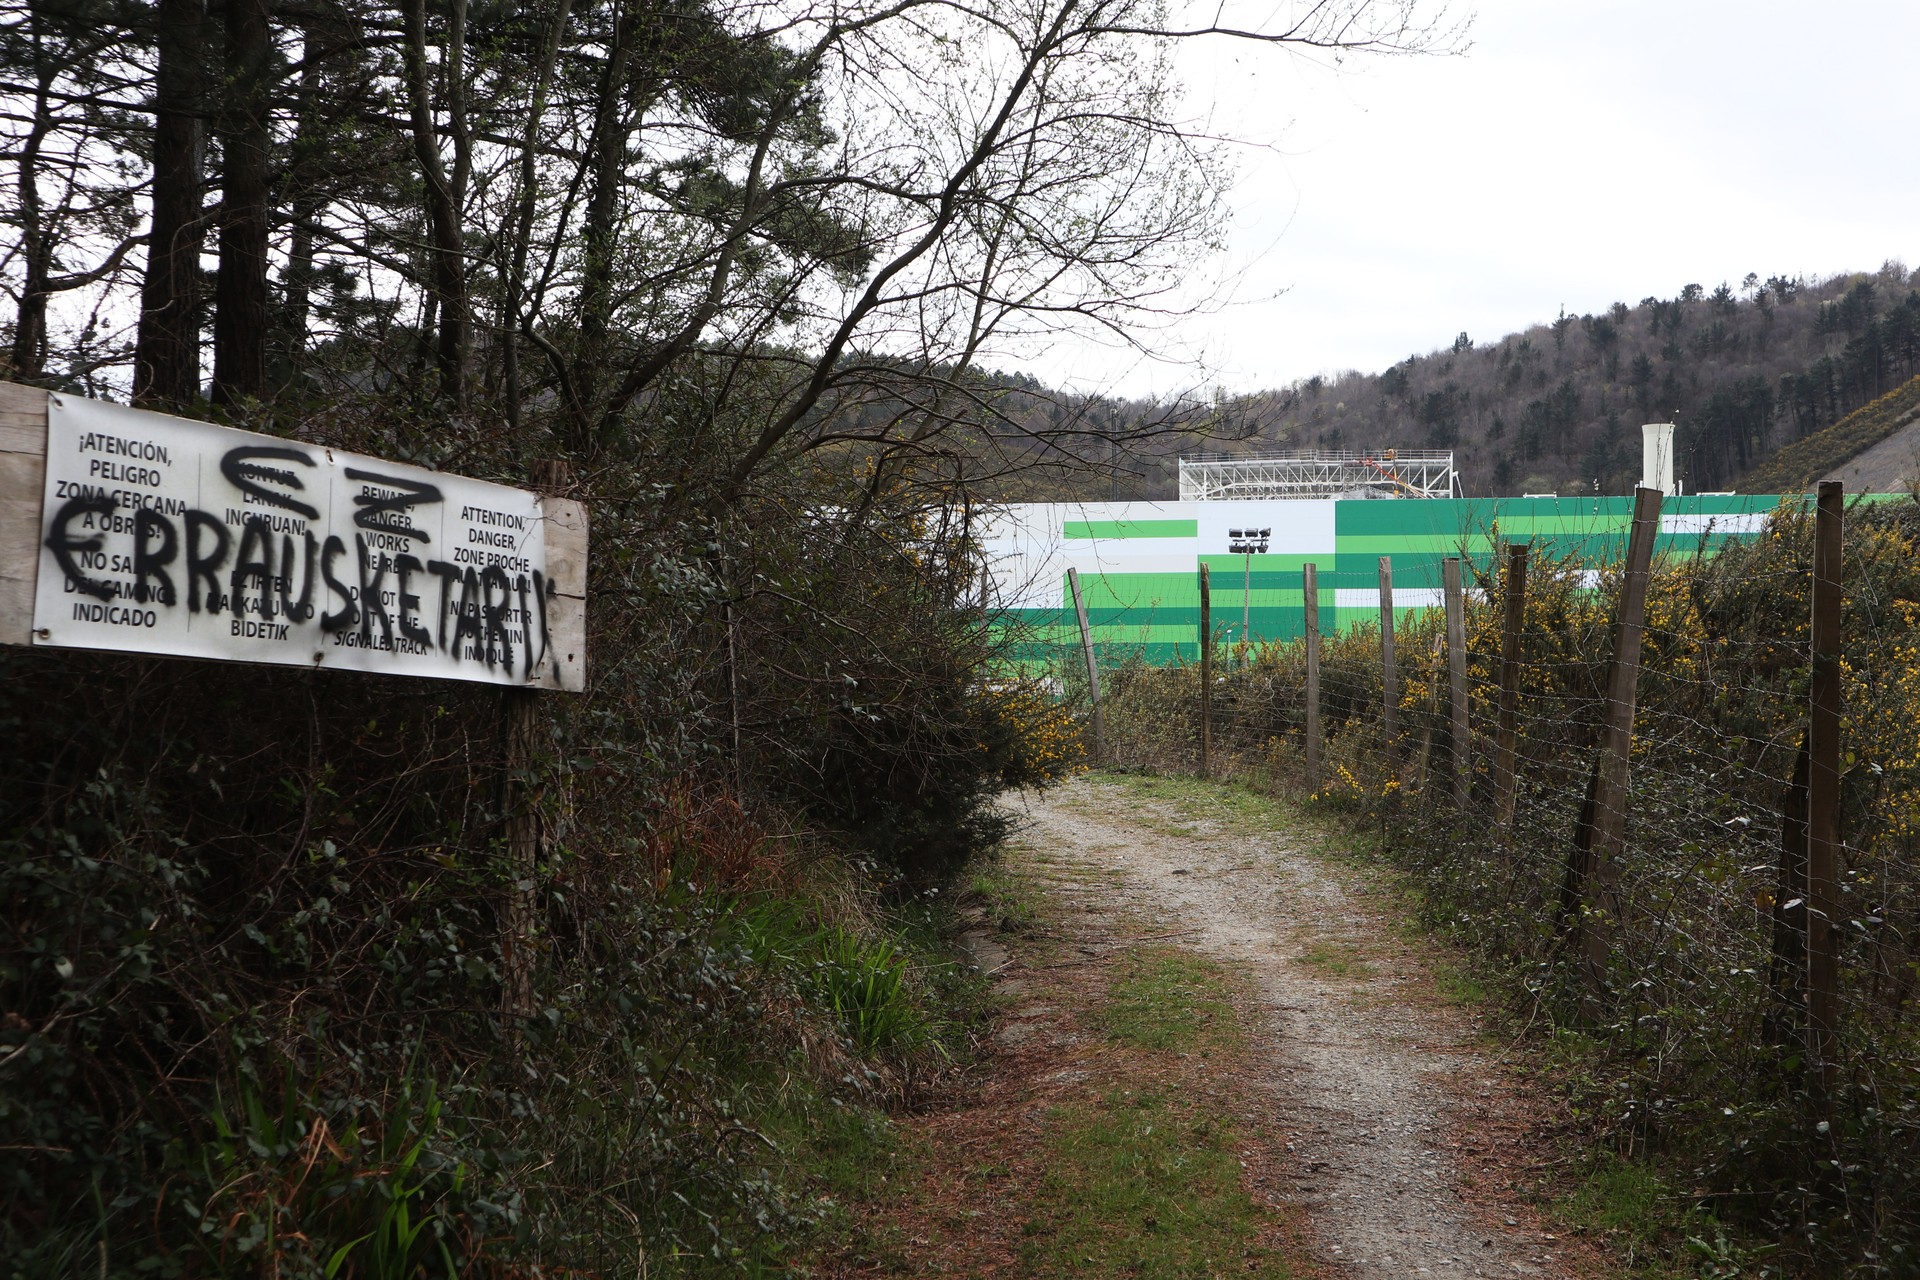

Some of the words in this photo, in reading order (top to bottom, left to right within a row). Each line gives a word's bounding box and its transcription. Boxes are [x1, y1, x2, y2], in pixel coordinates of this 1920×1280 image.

[79, 432, 172, 467] ¡ATENCIÓN,
[90, 459, 161, 487] PELIGRO
[111, 489, 187, 517] CERCANA
[82, 512, 95, 529] A
[100, 514, 161, 539] OBRS!
[226, 508, 306, 536] INGRUAN!
[461, 505, 526, 533] ATTENTION,
[365, 531, 410, 553] WORKS
[469, 528, 517, 552] DANGER,
[80, 551, 107, 570] NO
[453, 547, 484, 566] ZONE
[487, 552, 530, 573] PROCHE
[73, 603, 156, 628] INDICADO
[231, 620, 290, 640] BIDETIK
[395, 637, 427, 656] TRACK
